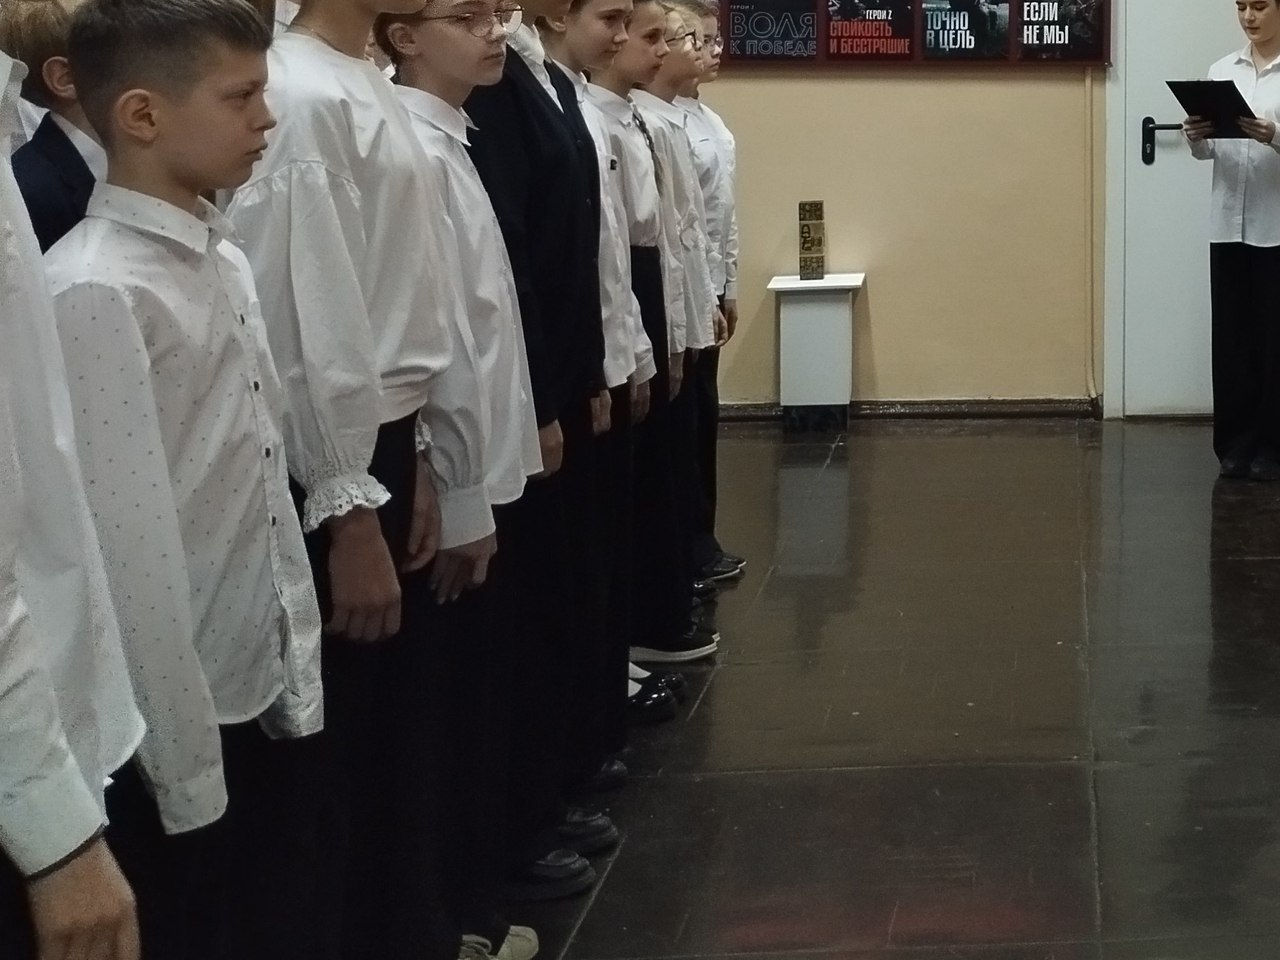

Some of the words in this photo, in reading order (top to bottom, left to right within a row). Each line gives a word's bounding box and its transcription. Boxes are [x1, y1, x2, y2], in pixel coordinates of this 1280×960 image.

[866, 10, 886, 19] ГЕРОИ
[888, 10, 892, 19] Z
[926, 11, 968, 30] ТОЧНО
[1023, 2, 1058, 21] ЕСЛИ
[730, 12, 817, 38] ВОЛЯ
[830, 18, 892, 36] СТОЙКОСТЬ
[1023, 25, 1040, 44] НЕ
[1044, 25, 1069, 44] МЫ
[730, 40, 741, 54] К
[746, 40, 817, 56] ПОБЕДЕ
[830, 39, 837, 54] И
[841, 39, 910, 54] БЕССТРАШИЕ
[926, 31, 934, 48] В
[939, 30, 975, 51] ЦЕЛЬ
